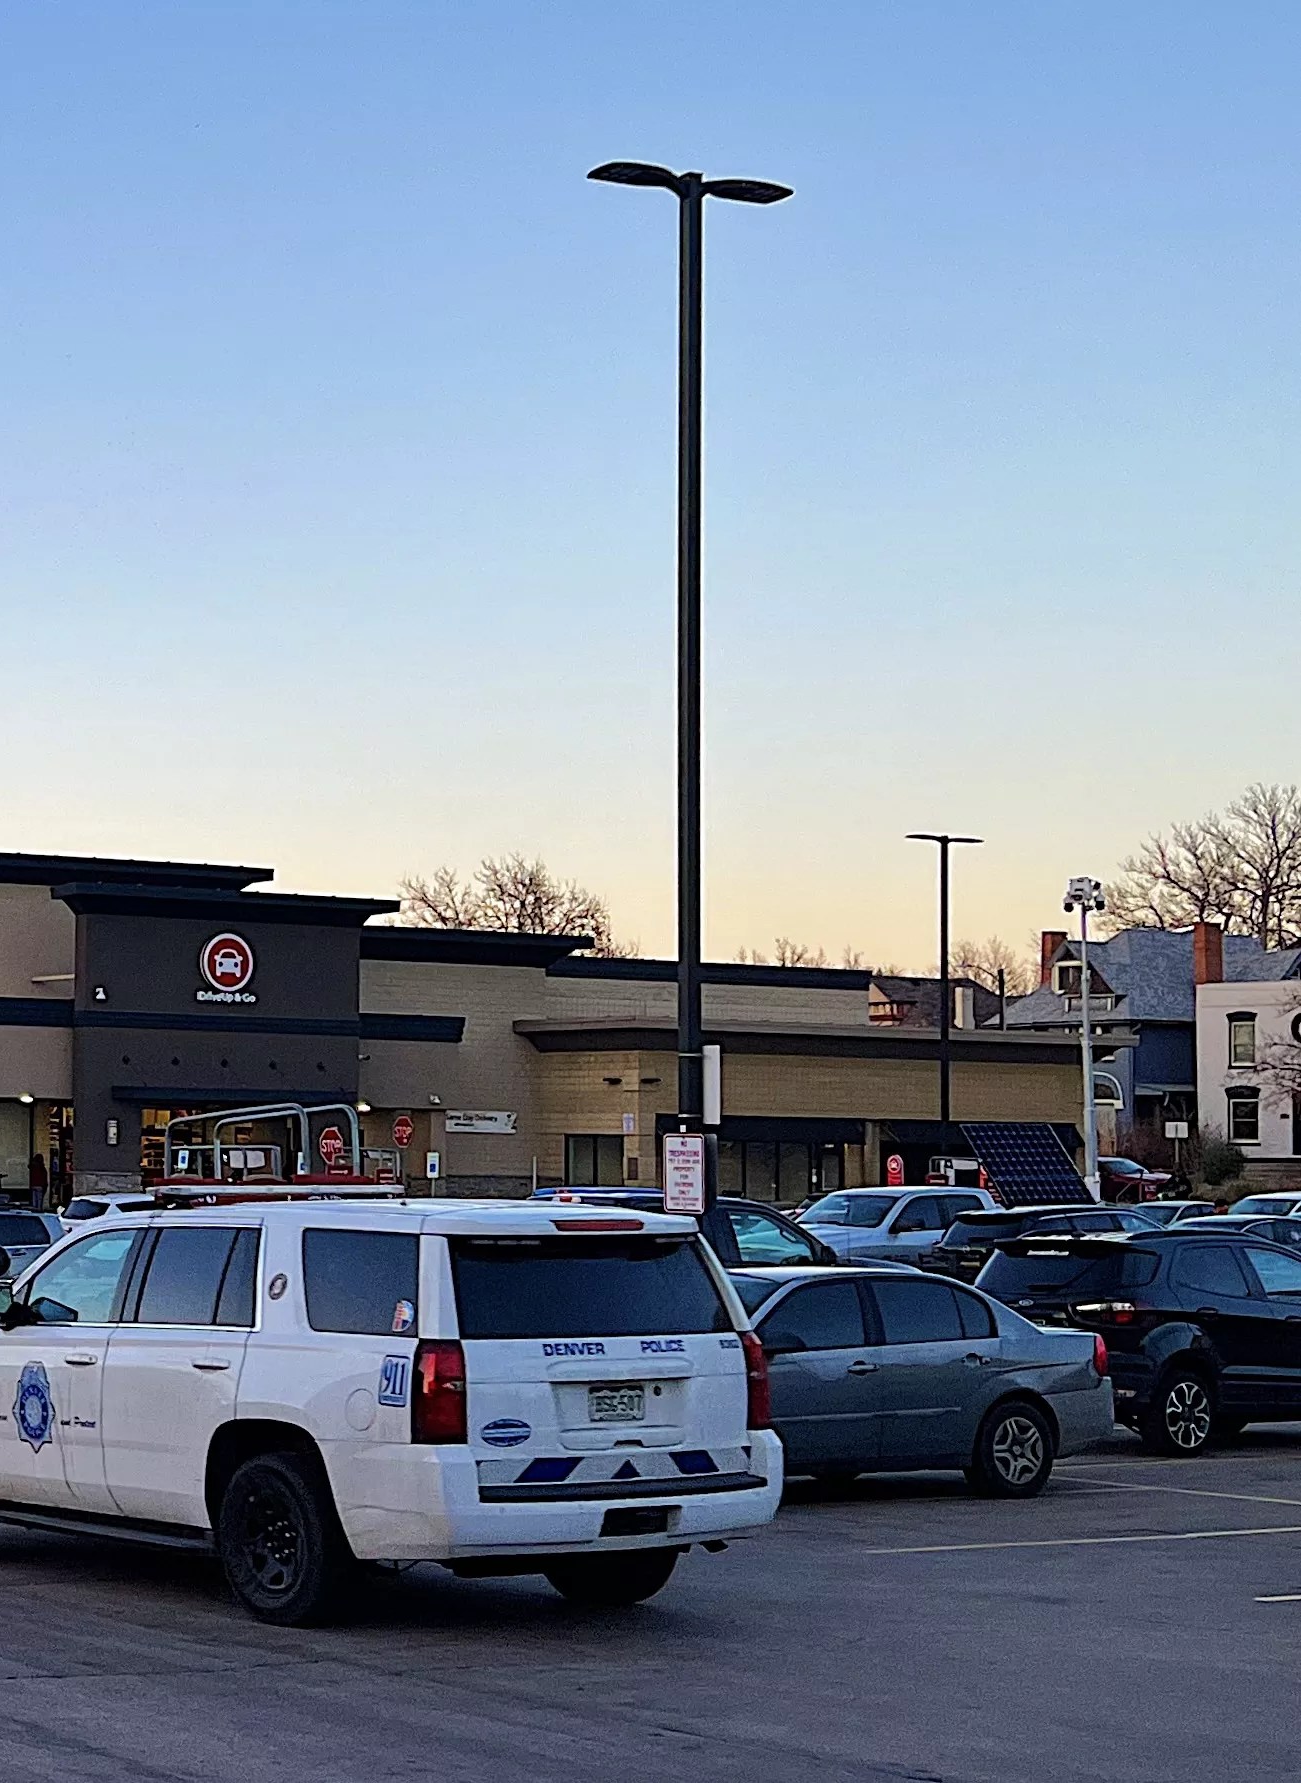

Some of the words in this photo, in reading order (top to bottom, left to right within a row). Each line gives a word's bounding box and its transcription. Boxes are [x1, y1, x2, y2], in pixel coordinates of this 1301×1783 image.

[394, 1126, 412, 1138] STOP
[321, 1139, 342, 1153] STOP
[542, 1342, 605, 1356] DENVER
[640, 1339, 686, 1353] POLICE
[382, 1359, 406, 1396] 911
